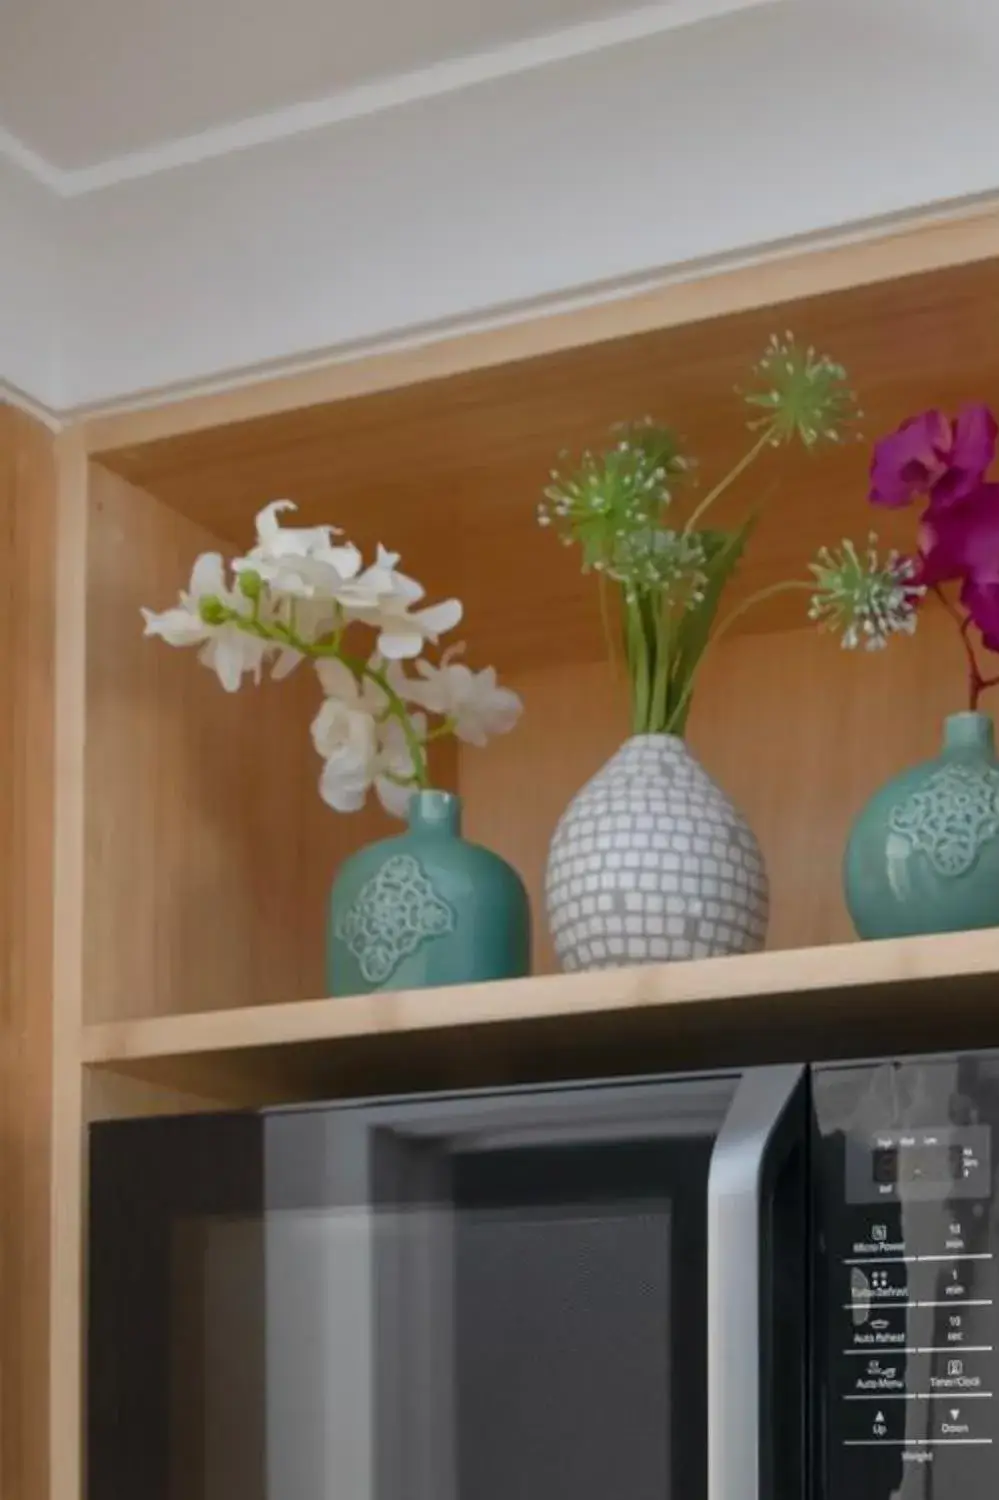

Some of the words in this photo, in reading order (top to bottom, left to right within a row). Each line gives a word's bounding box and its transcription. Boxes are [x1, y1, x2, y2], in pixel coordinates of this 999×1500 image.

[854, 1332, 875, 1343] Auto
[872, 1423, 887, 1436] Up
[941, 1423, 969, 1433] Down
